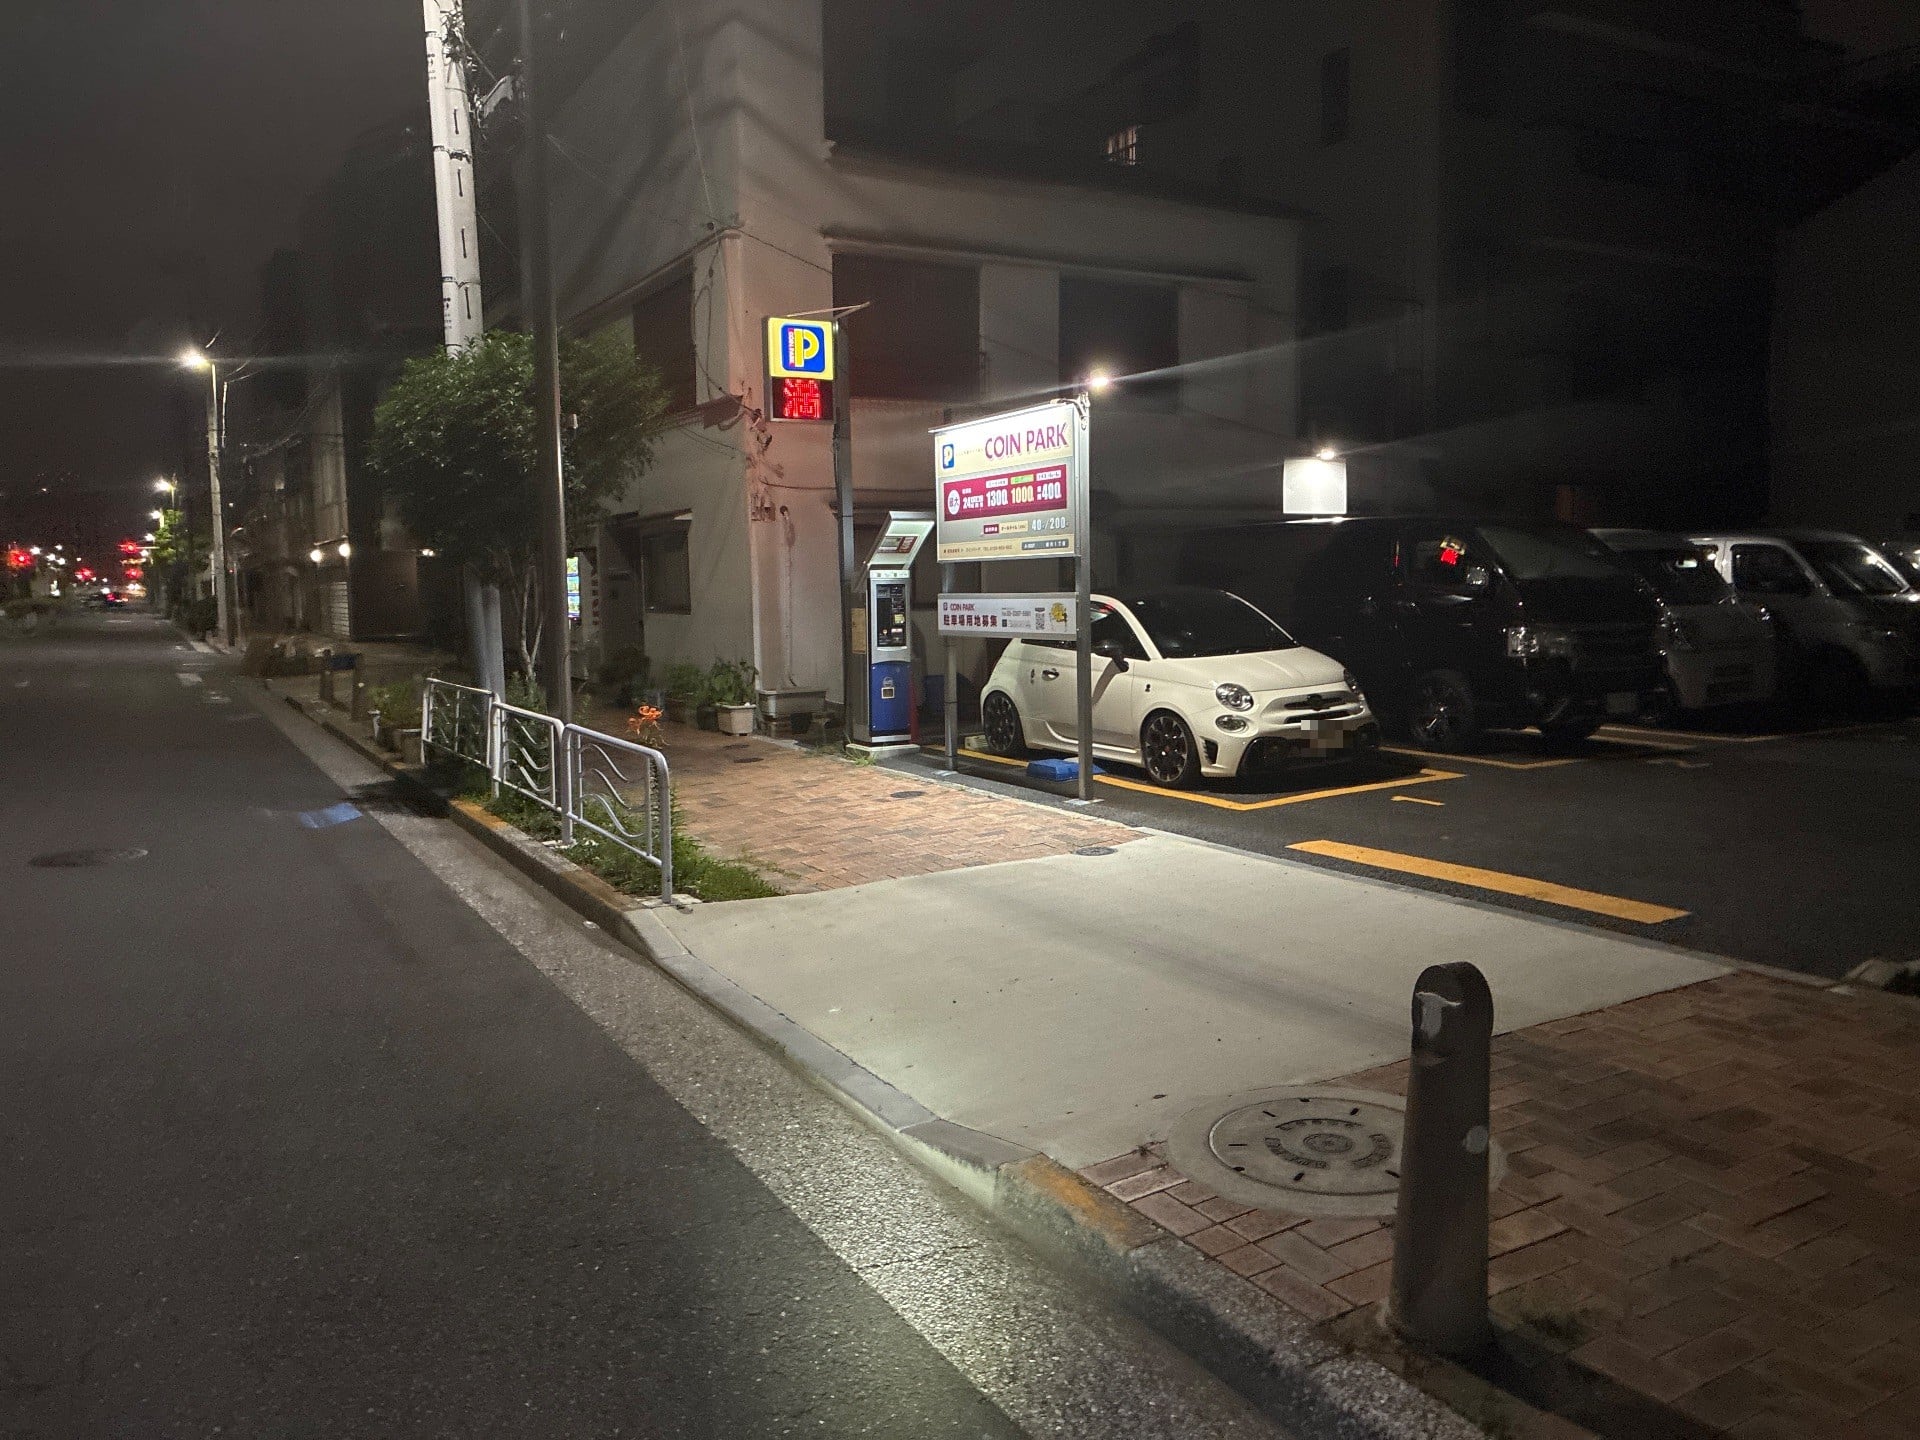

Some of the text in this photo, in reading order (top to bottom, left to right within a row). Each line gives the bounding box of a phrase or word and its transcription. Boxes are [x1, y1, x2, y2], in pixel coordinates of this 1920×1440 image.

[794, 328, 820, 367] P
[783, 378, 821, 418] 満
[985, 422, 1068, 459] COIN PARK
[986, 489, 1008, 507] 1300
[1011, 485, 1034, 504] 1000
[1042, 482, 1062, 500] 400
[950, 603, 975, 611] COIN PARK
[943, 614, 998, 628] 駐車場用地募集
